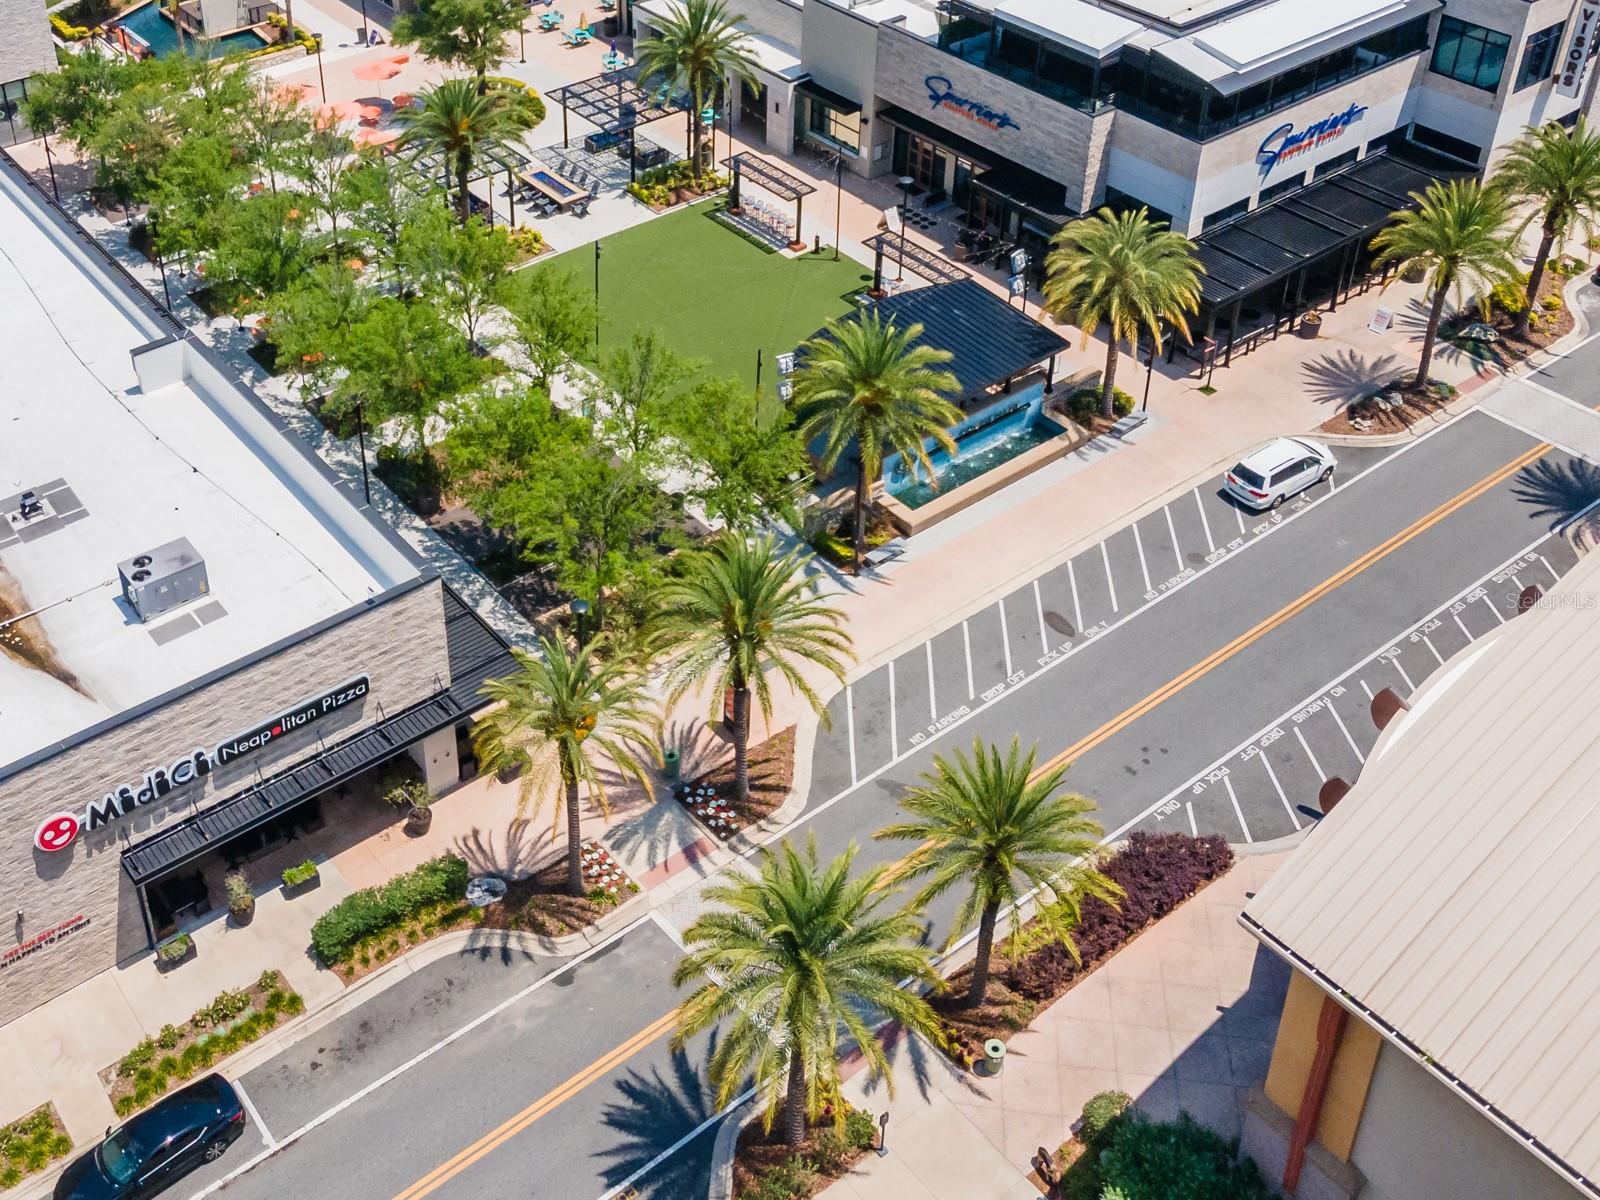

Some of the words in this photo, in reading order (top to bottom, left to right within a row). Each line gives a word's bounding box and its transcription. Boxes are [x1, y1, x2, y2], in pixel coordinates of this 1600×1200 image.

[1562, 8, 1594, 86] VISORS
[1143, 590, 1159, 601] NO
[1158, 568, 1196, 591] PARKING
[1205, 548, 1227, 564] DROP
[1227, 537, 1244, 550] OFF
[1252, 520, 1274, 535] PICK
[1270, 514, 1283, 524] UP
[1524, 551, 1540, 562] NO
[1492, 560, 1528, 584] PARKING
[1466, 586, 1488, 604] DROP
[1449, 601, 1466, 616] OFF
[1420, 618, 1442, 634] PICK
[1409, 631, 1423, 643] UP
[1377, 646, 1402, 665] ONLY
[908, 732, 926, 746] NO
[928, 705, 971, 734] PARKING
[980, 682, 1007, 702] DROP
[1007, 670, 1028, 685] OFF
[1037, 650, 1061, 667] PICK
[1059, 641, 1073, 653] UP
[1084, 620, 1109, 638] ONLY
[1330, 685, 1347, 697] NO
[1291, 696, 1332, 724] PARKING
[222, 708, 317, 761] Neapolitan
[322, 683, 366, 712] Pizza
[1260, 726, 1286, 748] DROP
[1240, 744, 1260, 762] OFF
[1204, 765, 1231, 784] PICK
[1192, 781, 1208, 795] UP
[1152, 799, 1181, 822] ONLY
[9, 943, 42, 965] HAPPEN
[44, 937, 56, 946] TO
[57, 918, 91, 940] ANYONE
